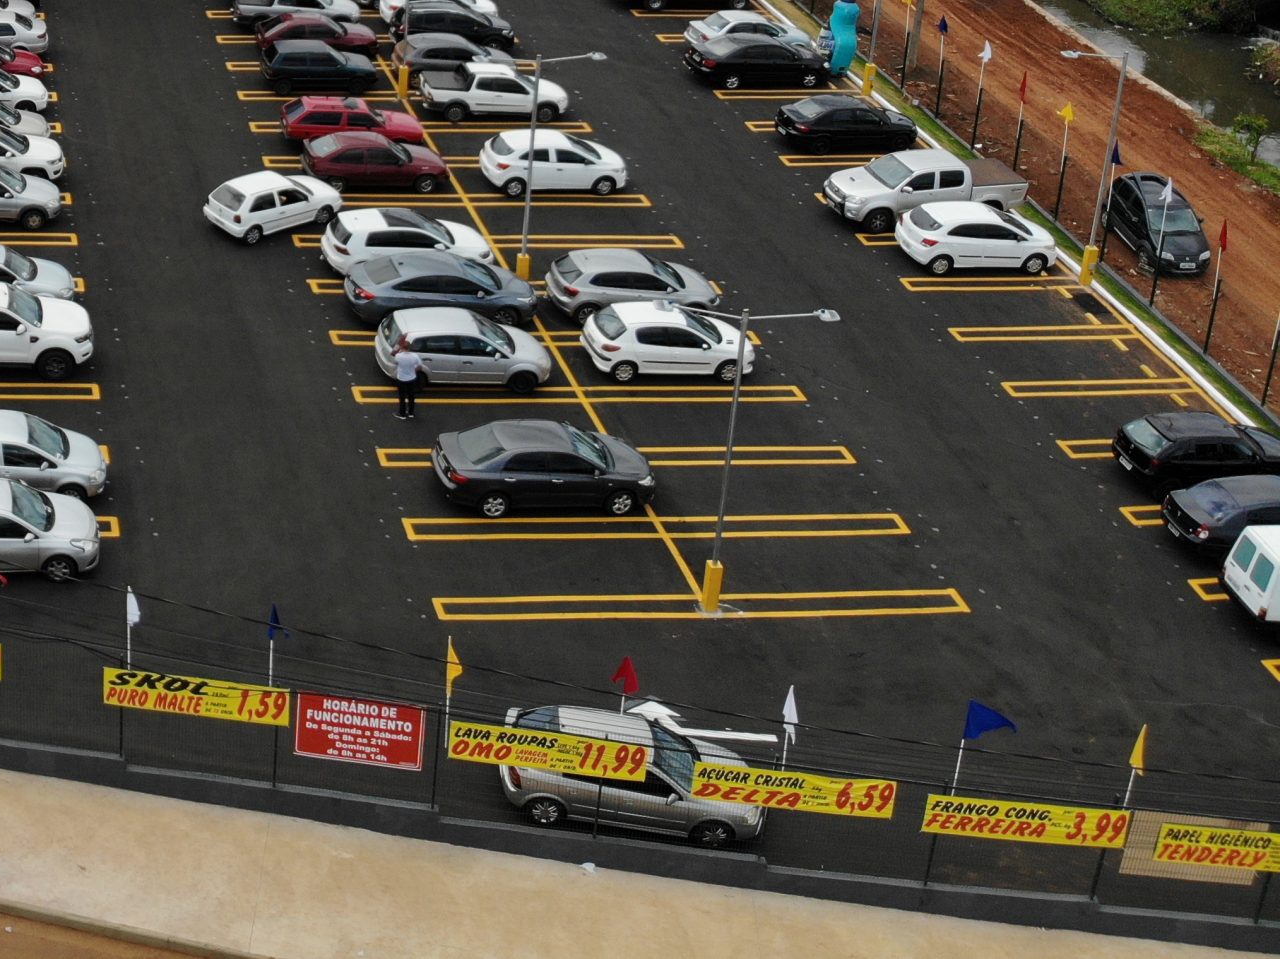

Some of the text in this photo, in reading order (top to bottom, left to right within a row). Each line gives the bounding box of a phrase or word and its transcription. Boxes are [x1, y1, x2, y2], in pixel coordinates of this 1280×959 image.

[108, 671, 209, 696] SKOL
[106, 687, 203, 714] PURO MALTE
[237, 689, 287, 721] 1,59
[323, 699, 397, 718] HORÁRIO DE
[307, 709, 412, 732] FUNCIONAMENTO
[321, 723, 362, 735] Segunda
[335, 741, 380, 753] Domingo:
[370, 738, 389, 746] 21h
[454, 727, 559, 749] LAVA ROUPAS
[370, 753, 387, 762] 14h
[451, 739, 512, 761] OMO
[514, 755, 548, 765] PERFEITA
[515, 748, 549, 758] LAVAGEM
[579, 742, 647, 776] 11,99
[698, 767, 750, 784] AÇÚCAR
[754, 774, 805, 789] CRISTAL
[692, 782, 802, 808] DELTA
[835, 781, 895, 814] 6,59
[931, 800, 1053, 822] FRANGO CONG.
[925, 813, 1047, 838] FERREIRA
[1065, 811, 1127, 844] 3,99
[1163, 828, 1272, 849] PAPEL HIGIÊNICO
[1157, 843, 1267, 868] TENDERLY
